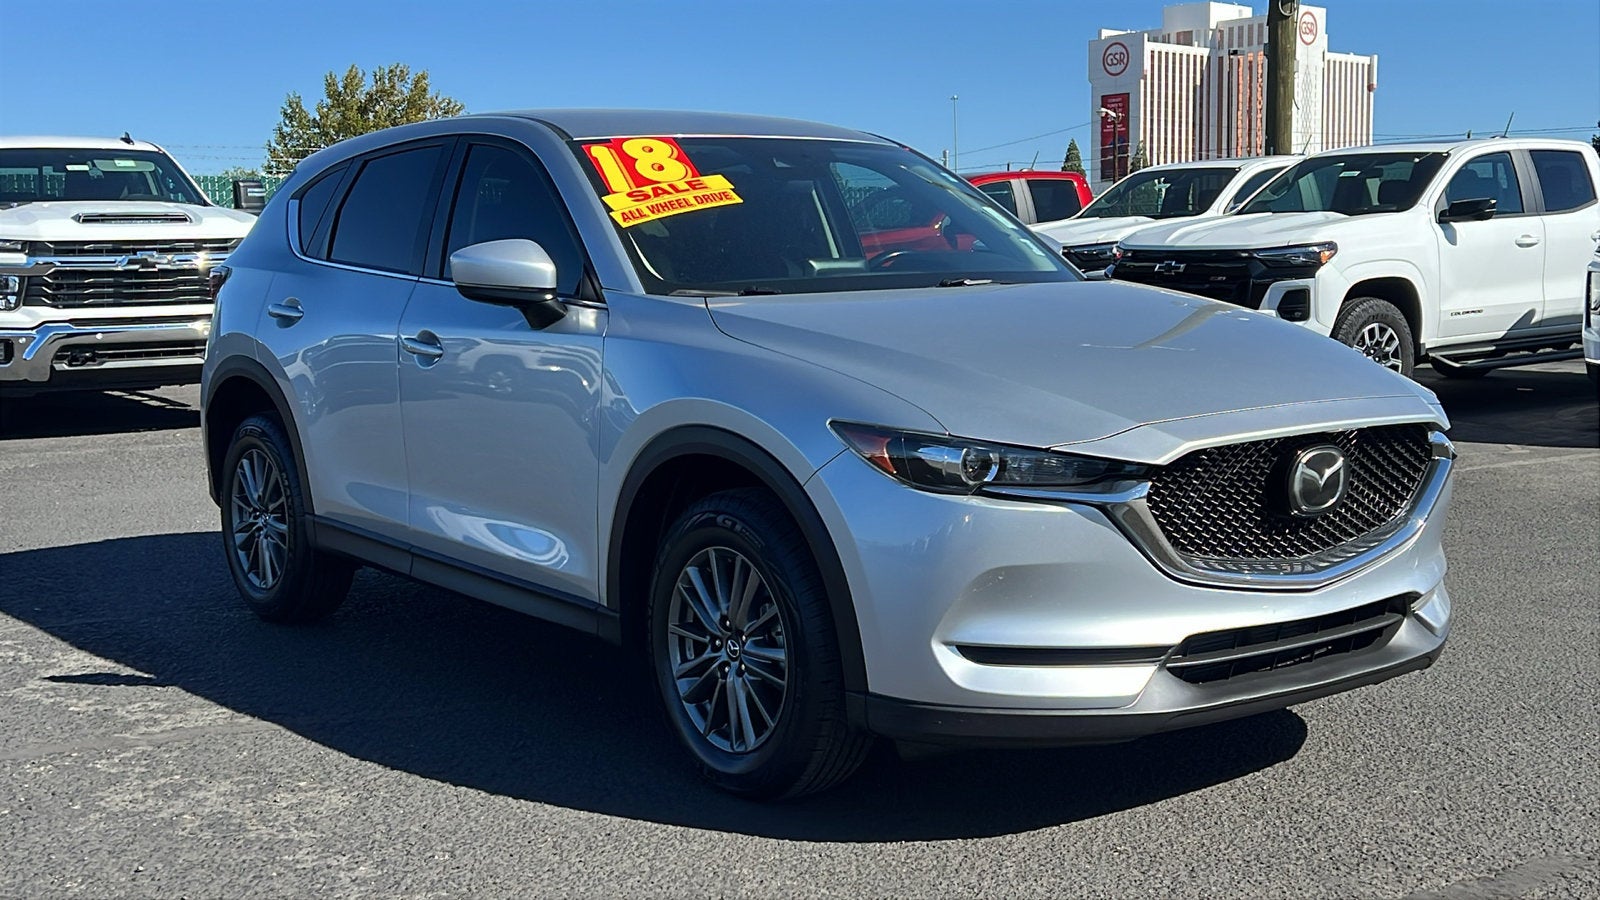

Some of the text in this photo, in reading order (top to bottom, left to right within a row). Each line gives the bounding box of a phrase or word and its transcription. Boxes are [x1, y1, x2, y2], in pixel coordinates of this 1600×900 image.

[1105, 51, 1126, 67] GSR
[590, 138, 692, 194] 18
[626, 179, 709, 203] SALE
[620, 191, 734, 224] ALL WHEEL DRIVE
